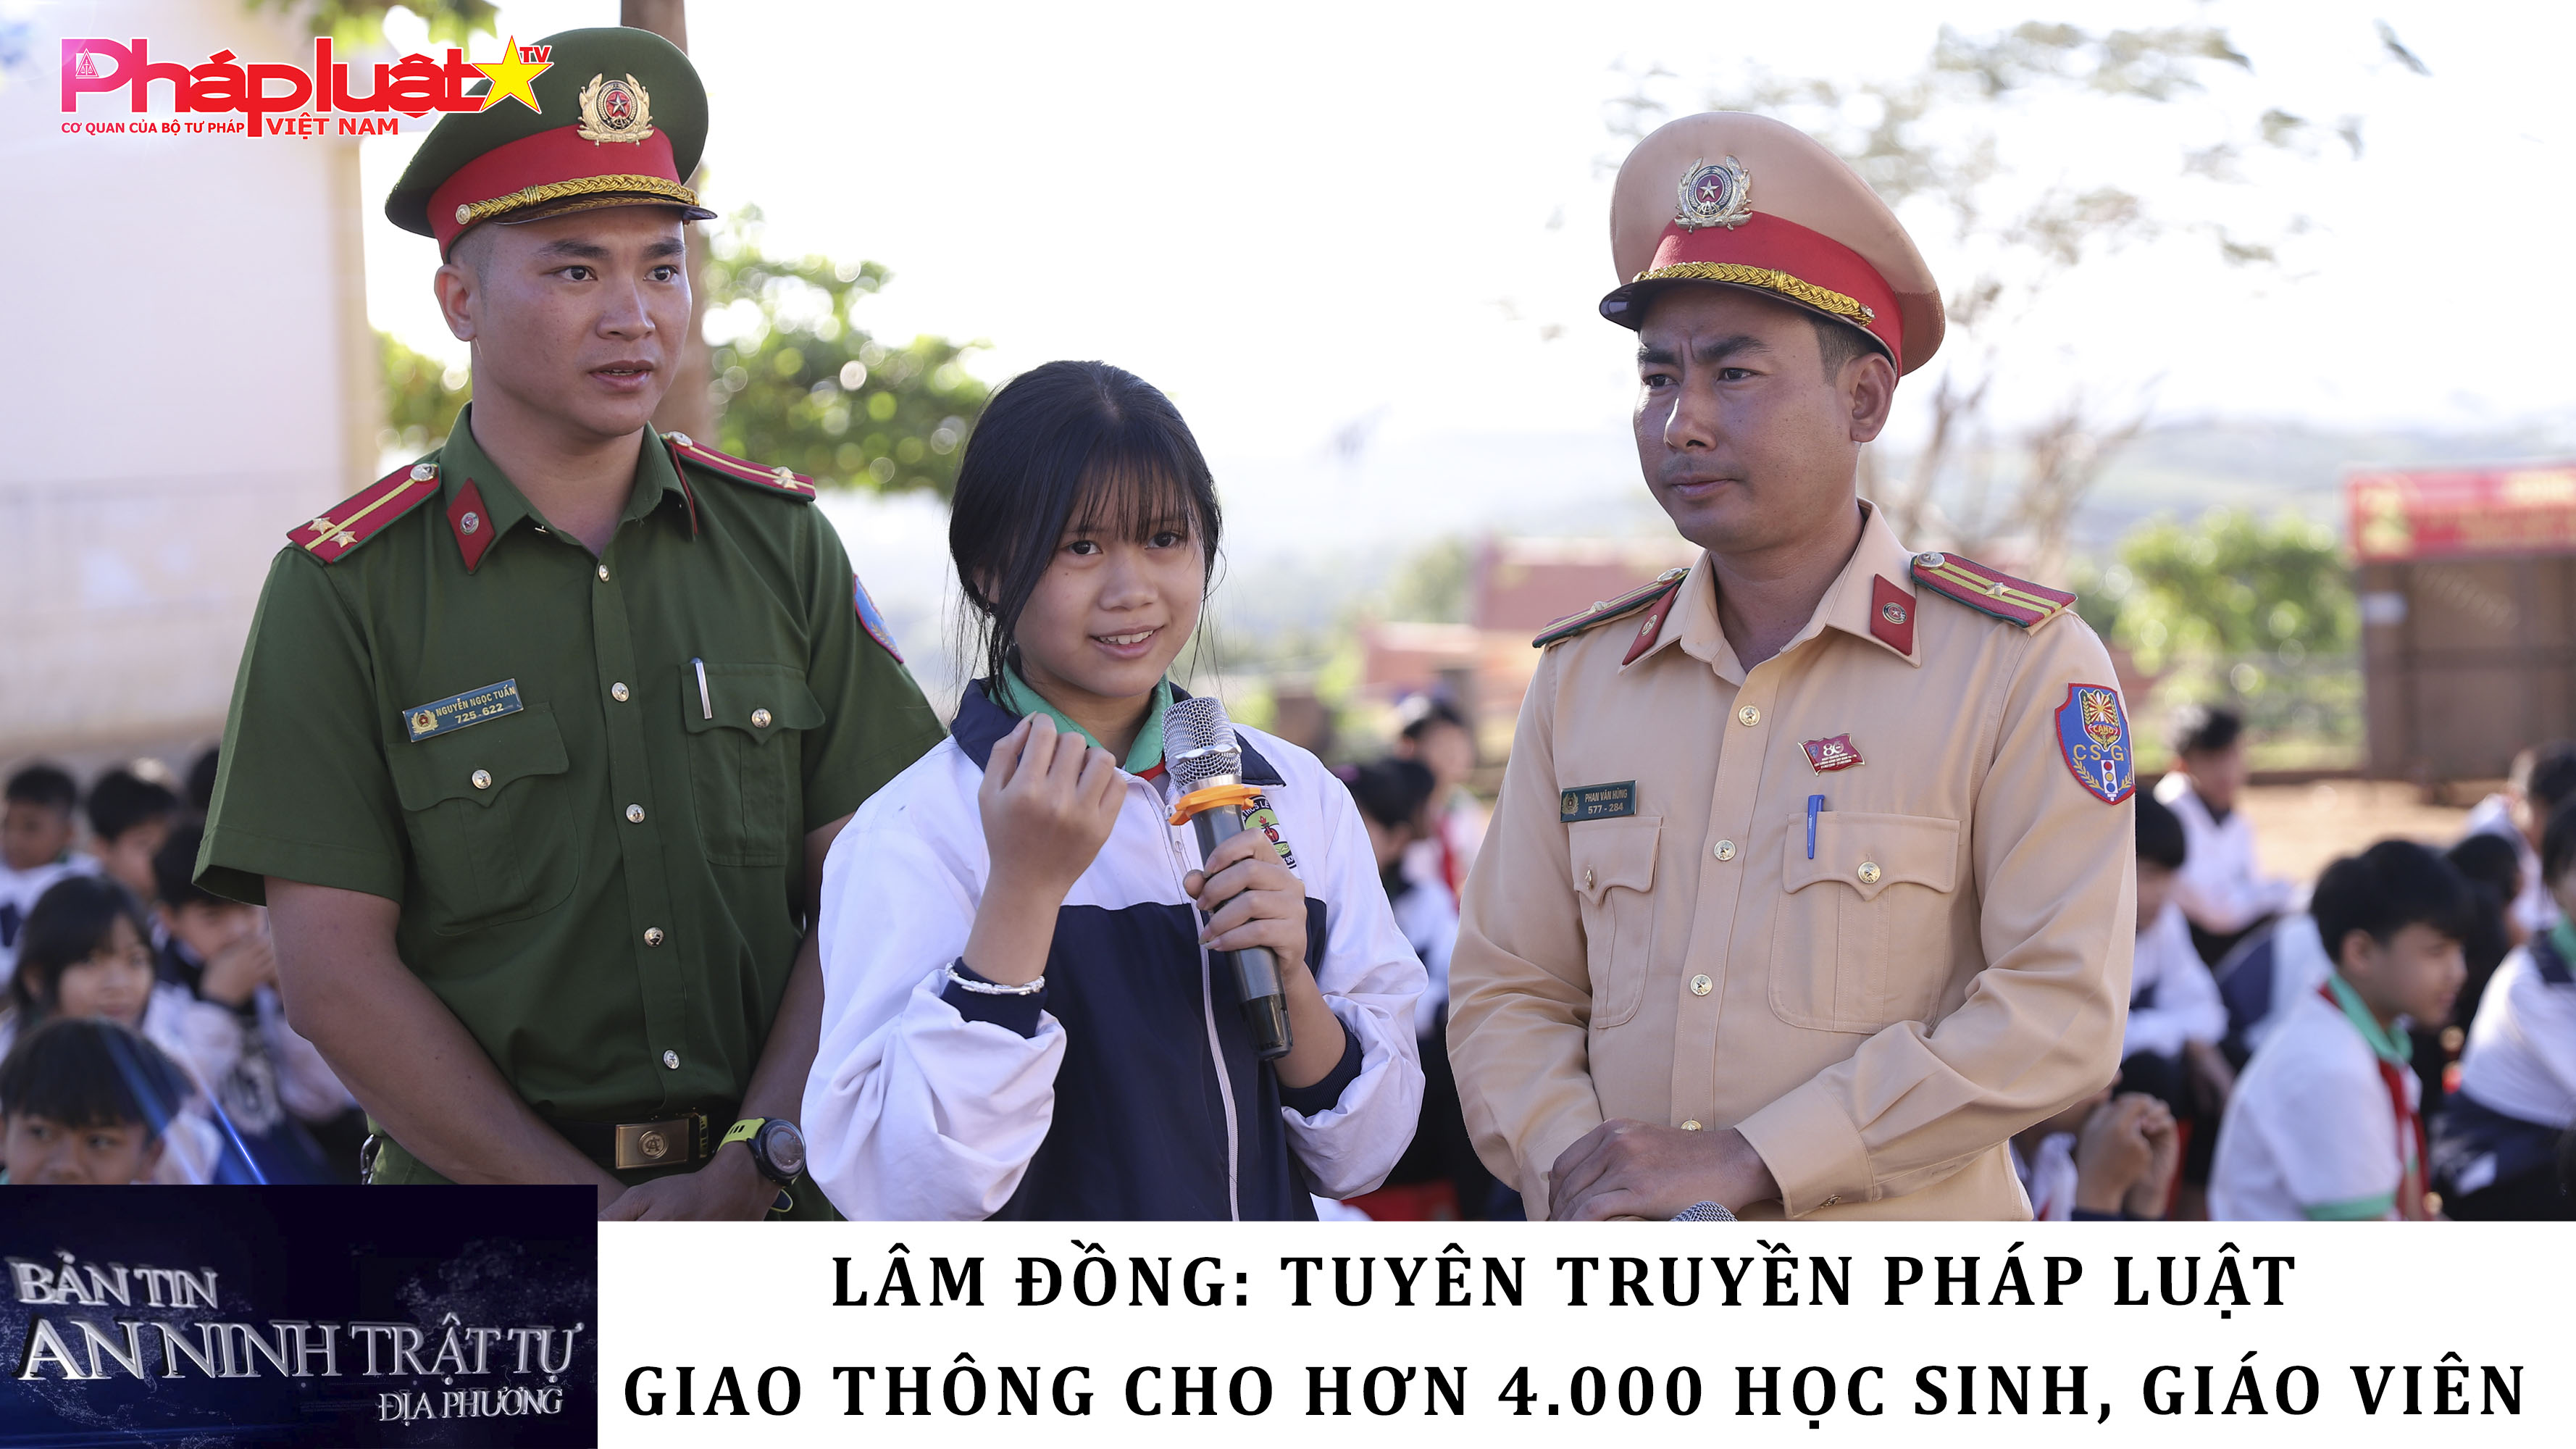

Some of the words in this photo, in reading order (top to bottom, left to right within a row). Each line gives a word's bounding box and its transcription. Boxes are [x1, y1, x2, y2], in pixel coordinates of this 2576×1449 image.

[435, 698, 469, 717] NGUYỄN
[469, 693, 493, 707] NGỌC
[493, 685, 516, 699] TUẤN
[1585, 792, 1599, 803] PHAN
[1600, 789, 1612, 801] VĂN
[1588, 804, 1602, 814] 577
[1608, 802, 1623, 812] 284
